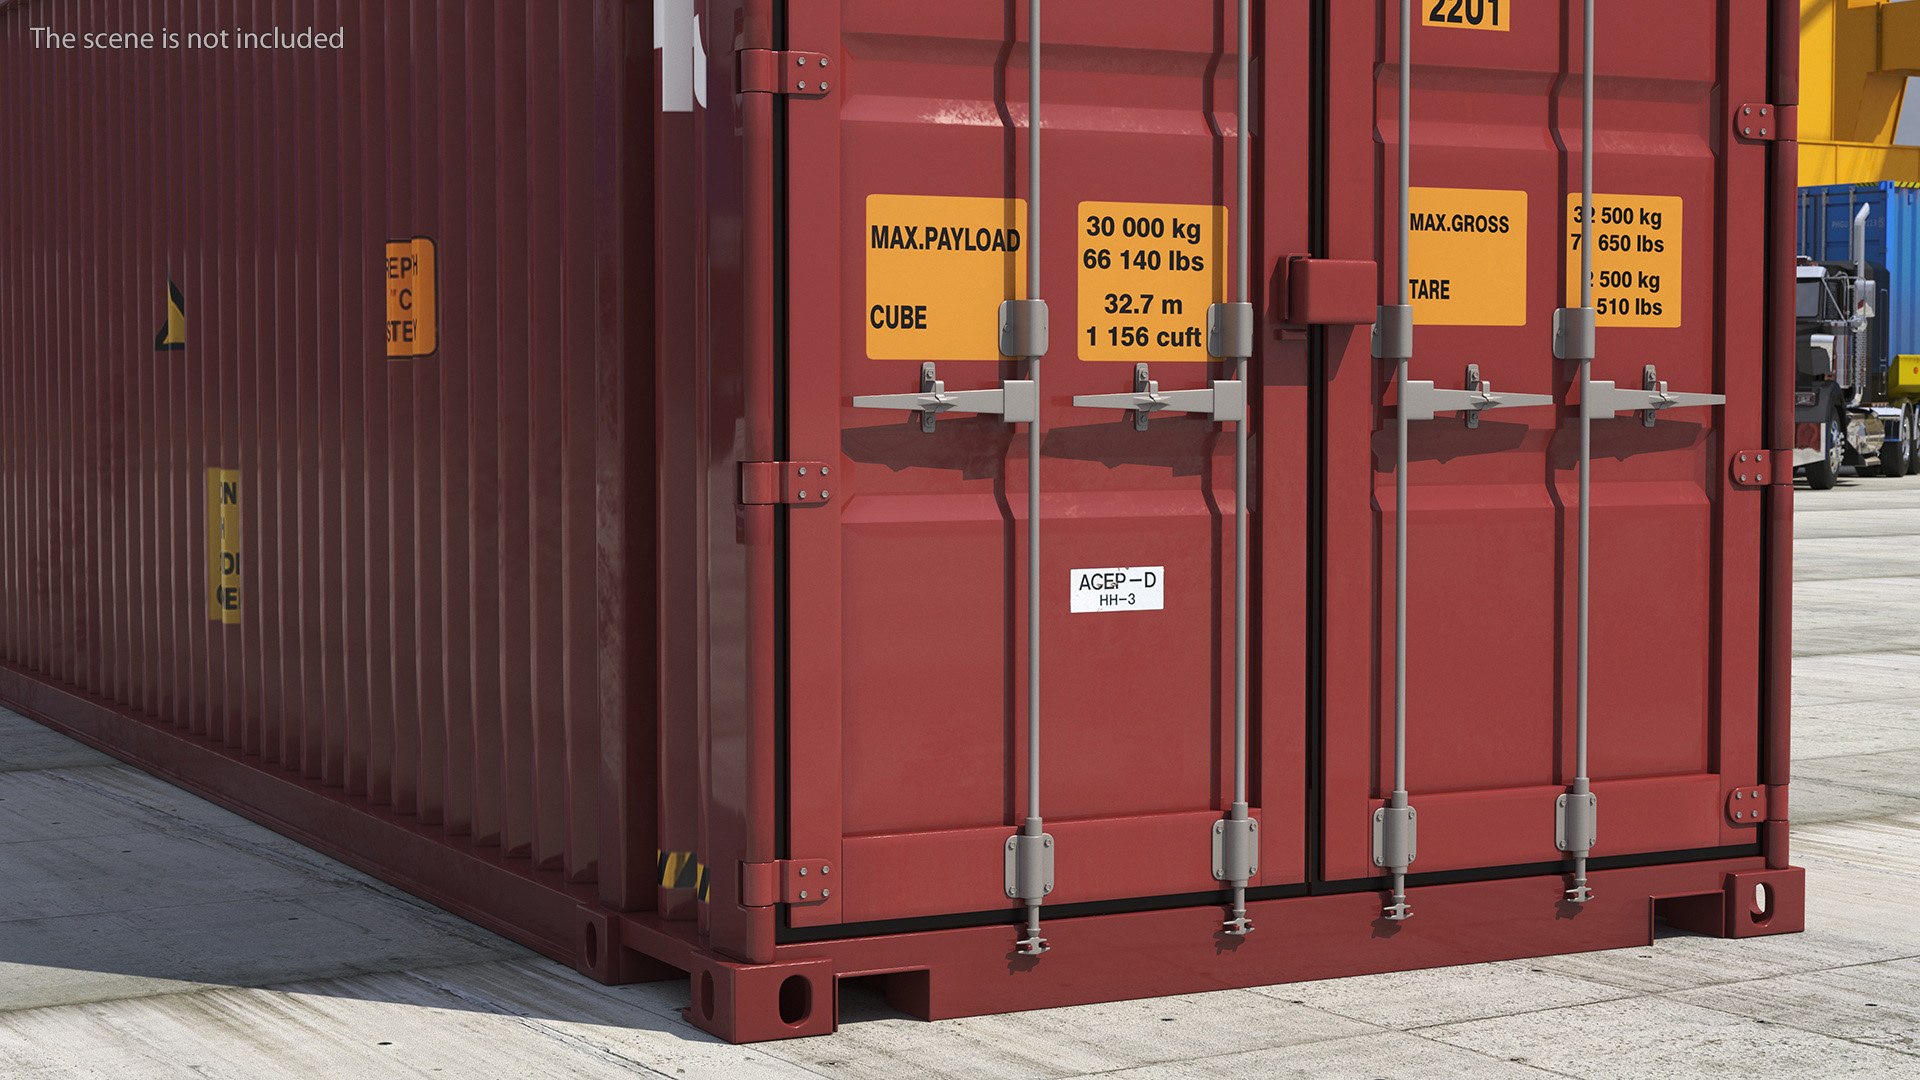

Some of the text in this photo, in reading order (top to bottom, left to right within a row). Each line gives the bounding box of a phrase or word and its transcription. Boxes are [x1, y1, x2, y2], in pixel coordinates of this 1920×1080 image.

[1429, 0, 1499, 26] 2201
[1086, 215, 1202, 244] 30 000 kg
[1410, 213, 1510, 234] MAX.GROSS
[1602, 206, 1634, 226] 500
[1640, 208, 1662, 231] kg
[871, 225, 1021, 253] MAX.PAYLOAD
[1598, 233, 1631, 252] 650
[1637, 234, 1665, 253] lbs
[1083, 248, 1205, 272] 66 140 lbs
[1408, 278, 1450, 300] TARE
[1599, 271, 1633, 289] 500
[1639, 271, 1660, 294] kg
[1104, 294, 1183, 315] 32.7 m
[1597, 298, 1663, 317] 510 lbs
[870, 304, 927, 330] CUBE
[1086, 327, 1202, 348] 1 156 cuft
[1099, 592, 1136, 606] HH-3
